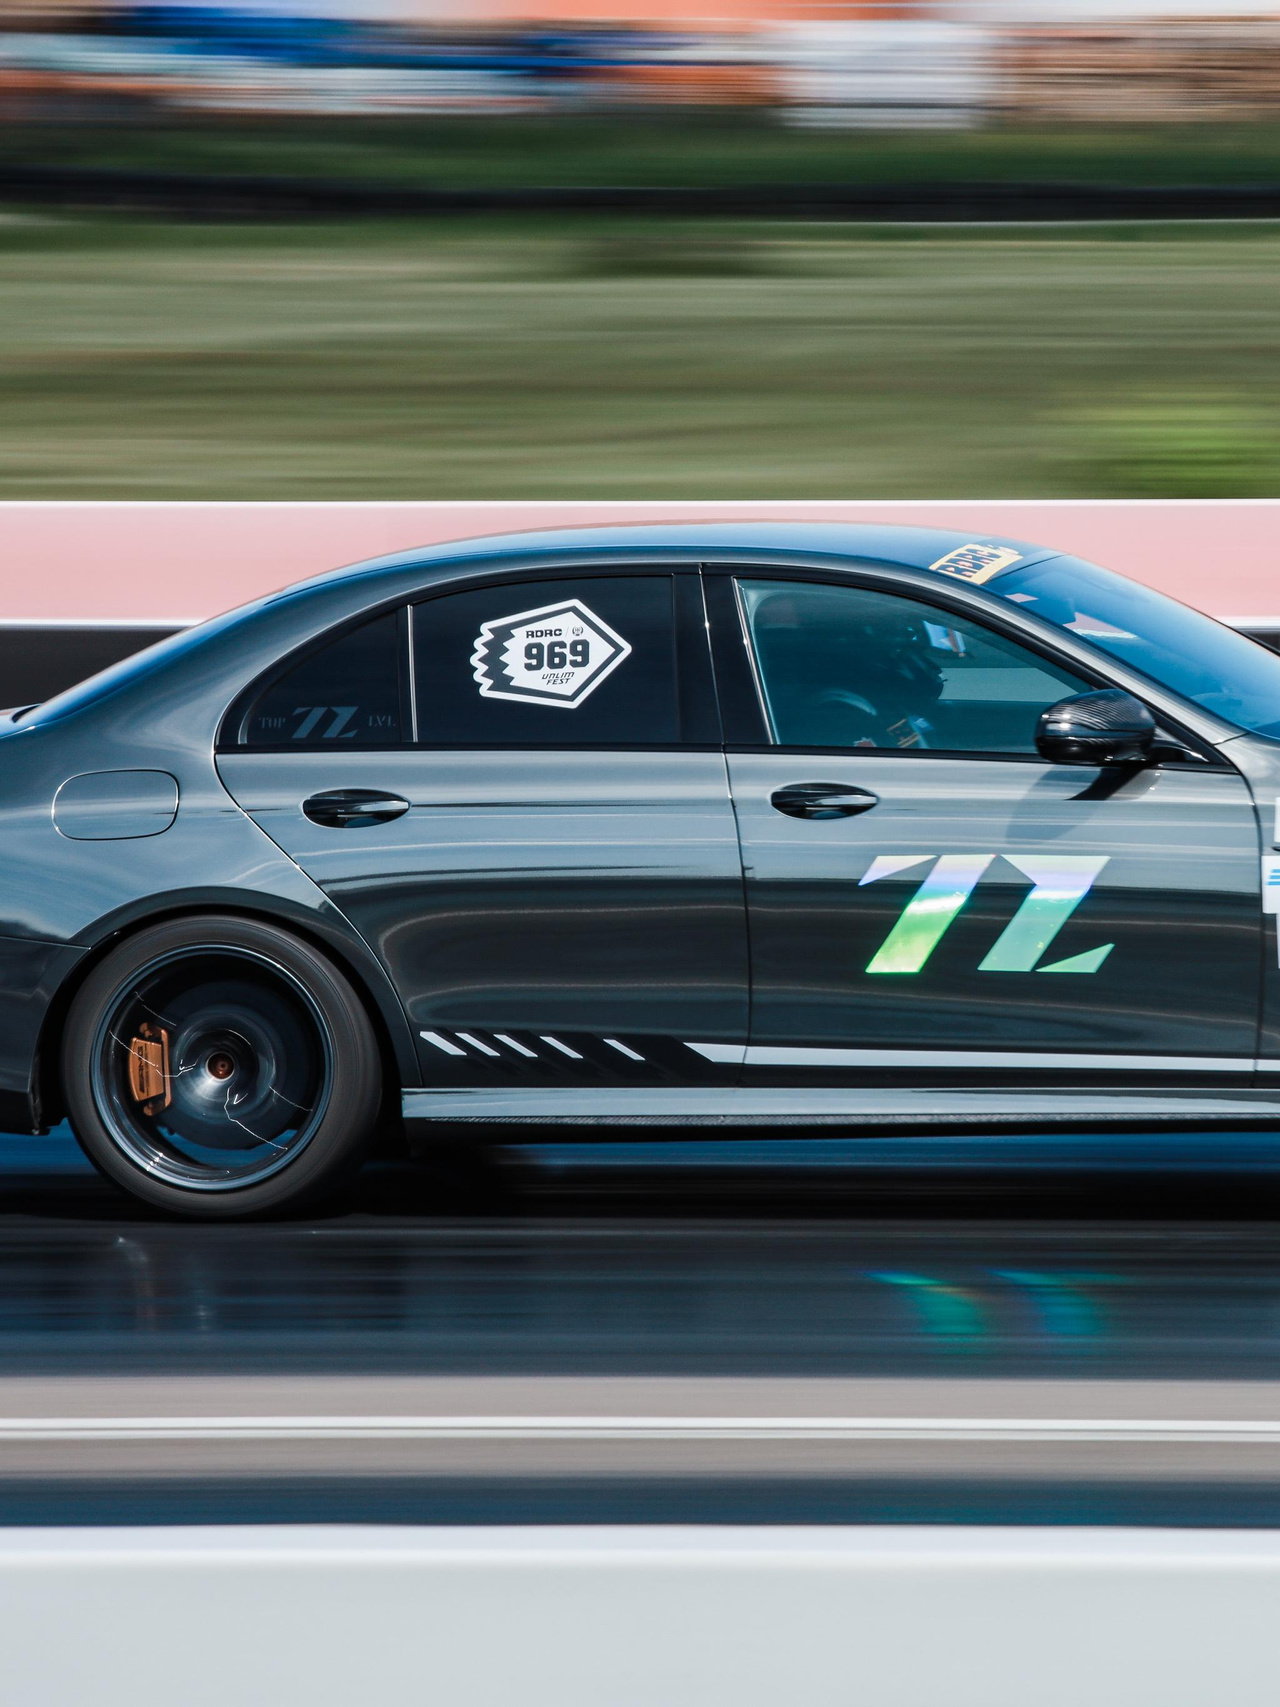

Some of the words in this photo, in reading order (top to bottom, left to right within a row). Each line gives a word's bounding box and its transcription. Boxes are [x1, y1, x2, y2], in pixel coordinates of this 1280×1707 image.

[525, 628, 563, 639] RDRC
[523, 638, 590, 672] 969
[546, 678, 571, 686] FEST
